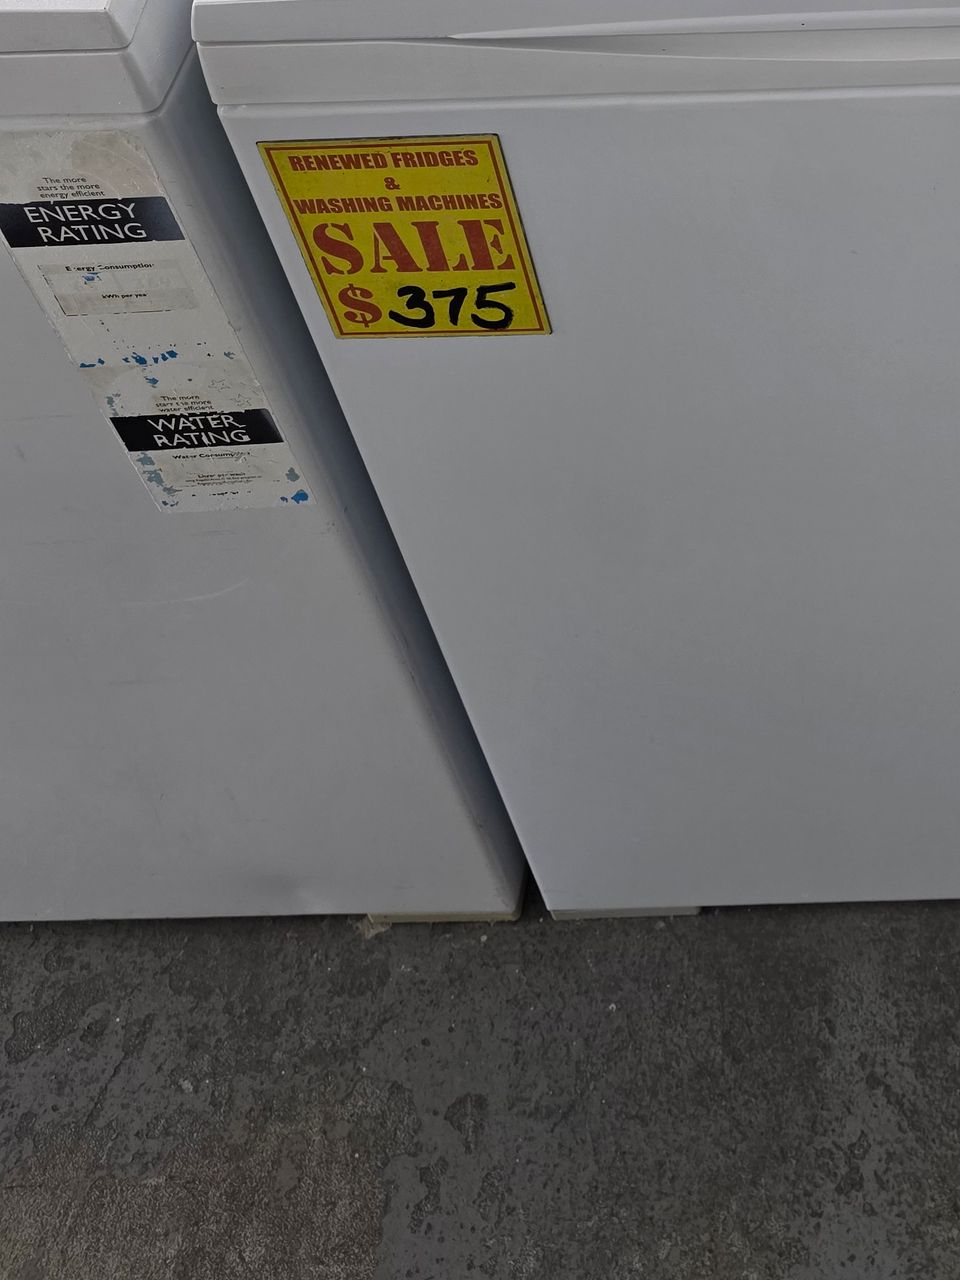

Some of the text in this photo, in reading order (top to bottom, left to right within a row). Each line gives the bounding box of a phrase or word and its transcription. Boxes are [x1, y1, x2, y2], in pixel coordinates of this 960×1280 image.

[288, 149, 479, 171] RENEWED FRIDGES
[384, 176, 401, 190] &
[23, 202, 135, 223] ENERGY
[293, 193, 503, 215] WASHING MACHINES
[37, 222, 147, 243] RATING
[312, 219, 516, 275] SALE
[147, 414, 246, 432] WATER
[153, 429, 251, 447] RATING
